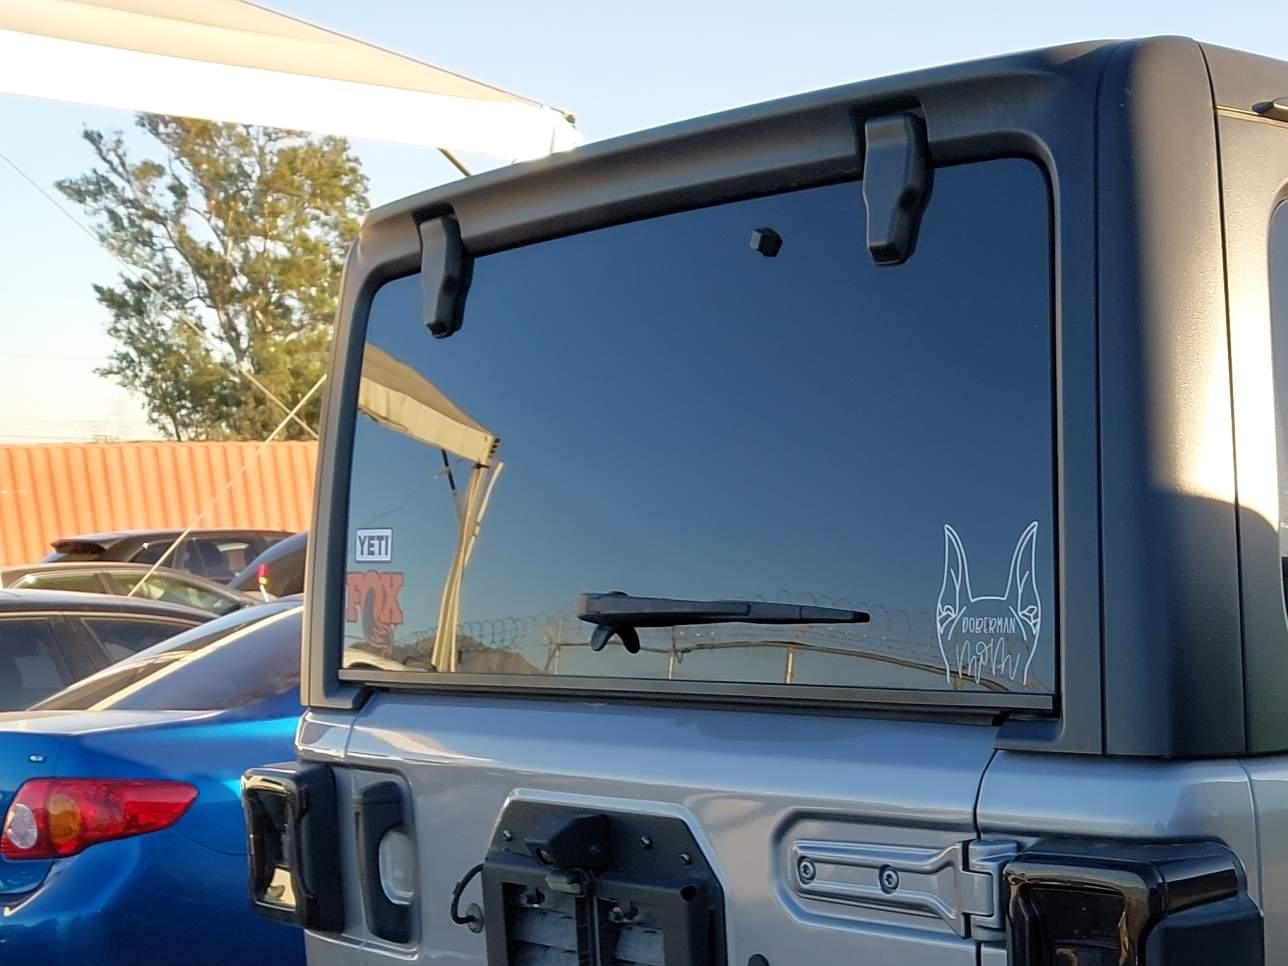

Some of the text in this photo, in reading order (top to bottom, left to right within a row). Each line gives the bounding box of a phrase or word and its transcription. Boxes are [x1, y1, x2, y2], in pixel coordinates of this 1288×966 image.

[358, 535, 389, 556] YETI
[345, 569, 406, 626] FOX
[961, 616, 1016, 634] DOBERMAN
